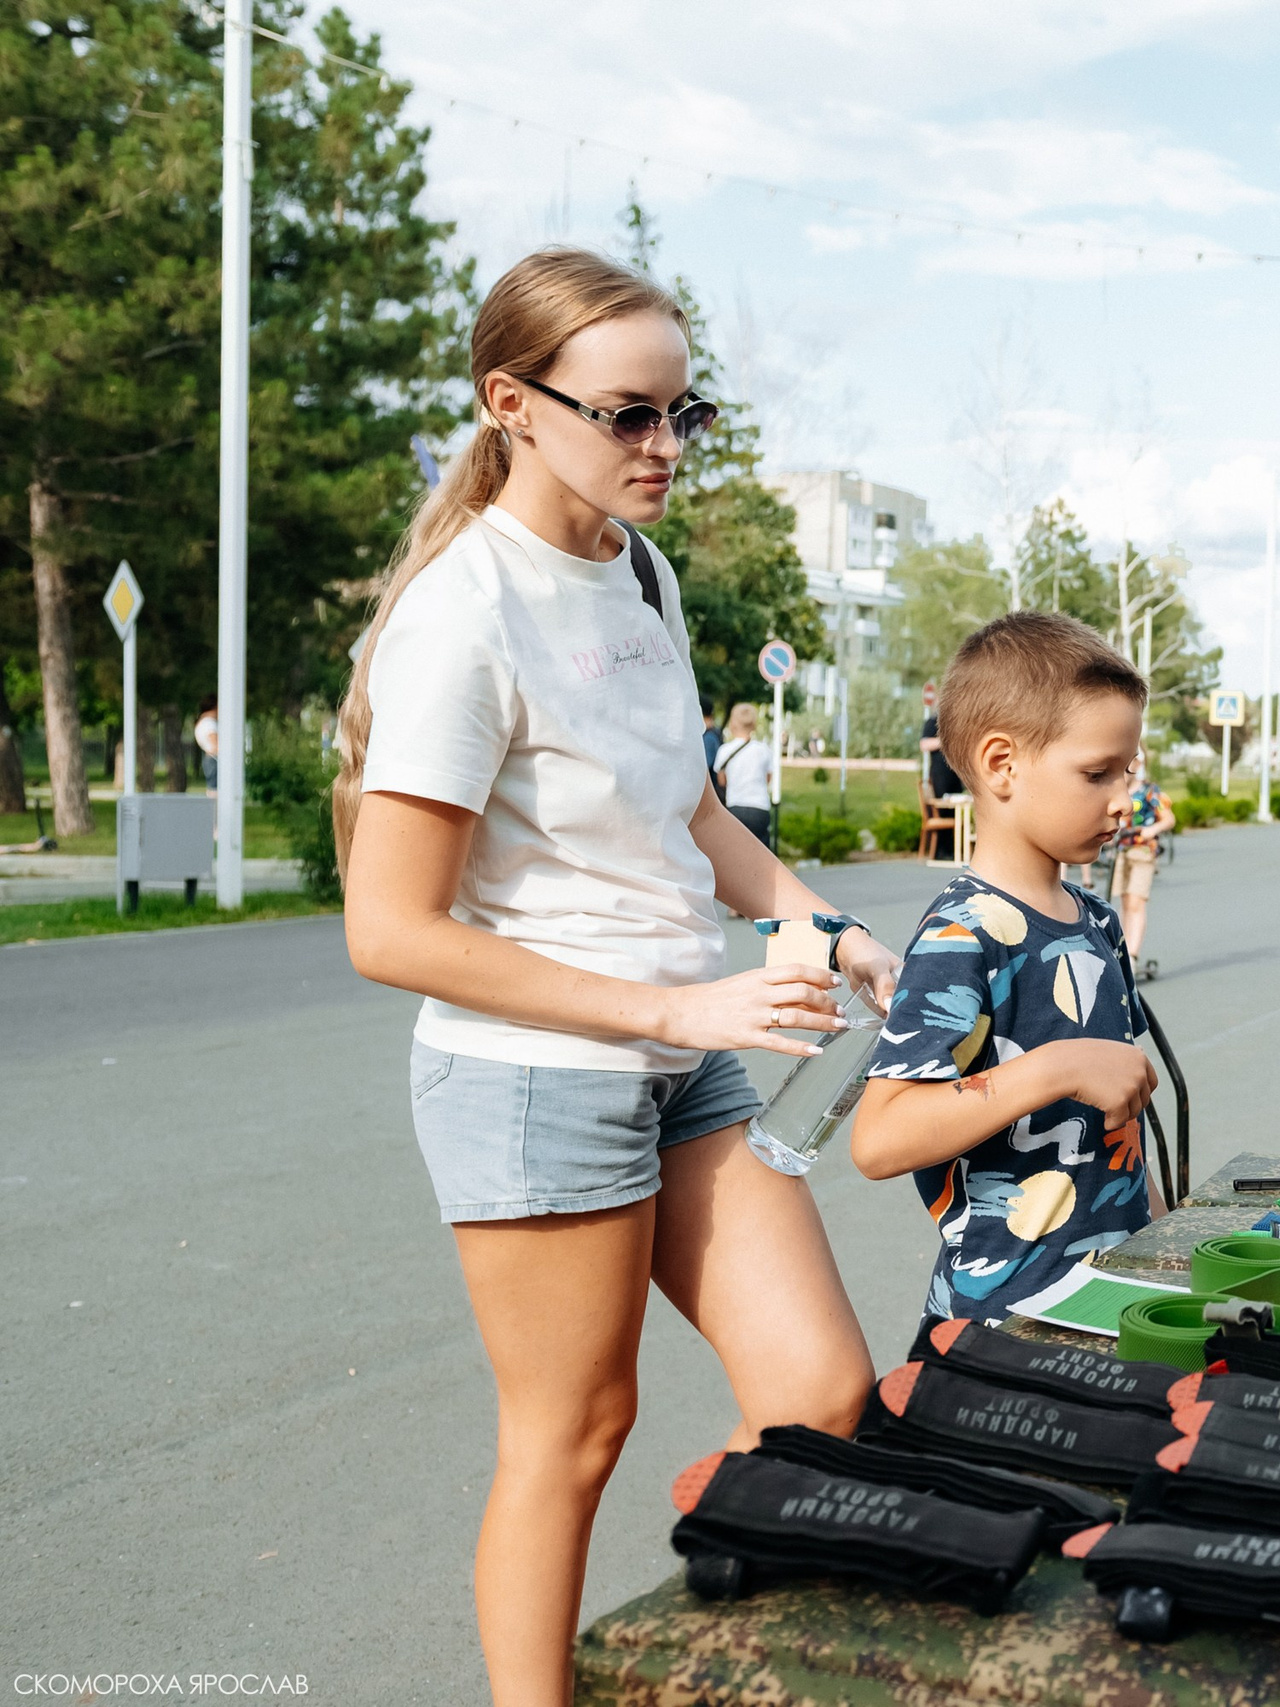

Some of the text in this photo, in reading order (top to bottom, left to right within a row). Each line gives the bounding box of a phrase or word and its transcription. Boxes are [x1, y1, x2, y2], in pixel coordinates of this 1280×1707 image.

[1028, 1357, 1138, 1392] НАРОДНЫЙ
[1055, 1350, 1124, 1375] ФРОНТ
[984, 1398, 1060, 1425] ФРОНТ
[955, 1406, 1078, 1449] НАРОДНЫЙ
[816, 1483, 903, 1508] ФРОНТ
[780, 1498, 920, 1532] НАРОДНЫЙ
